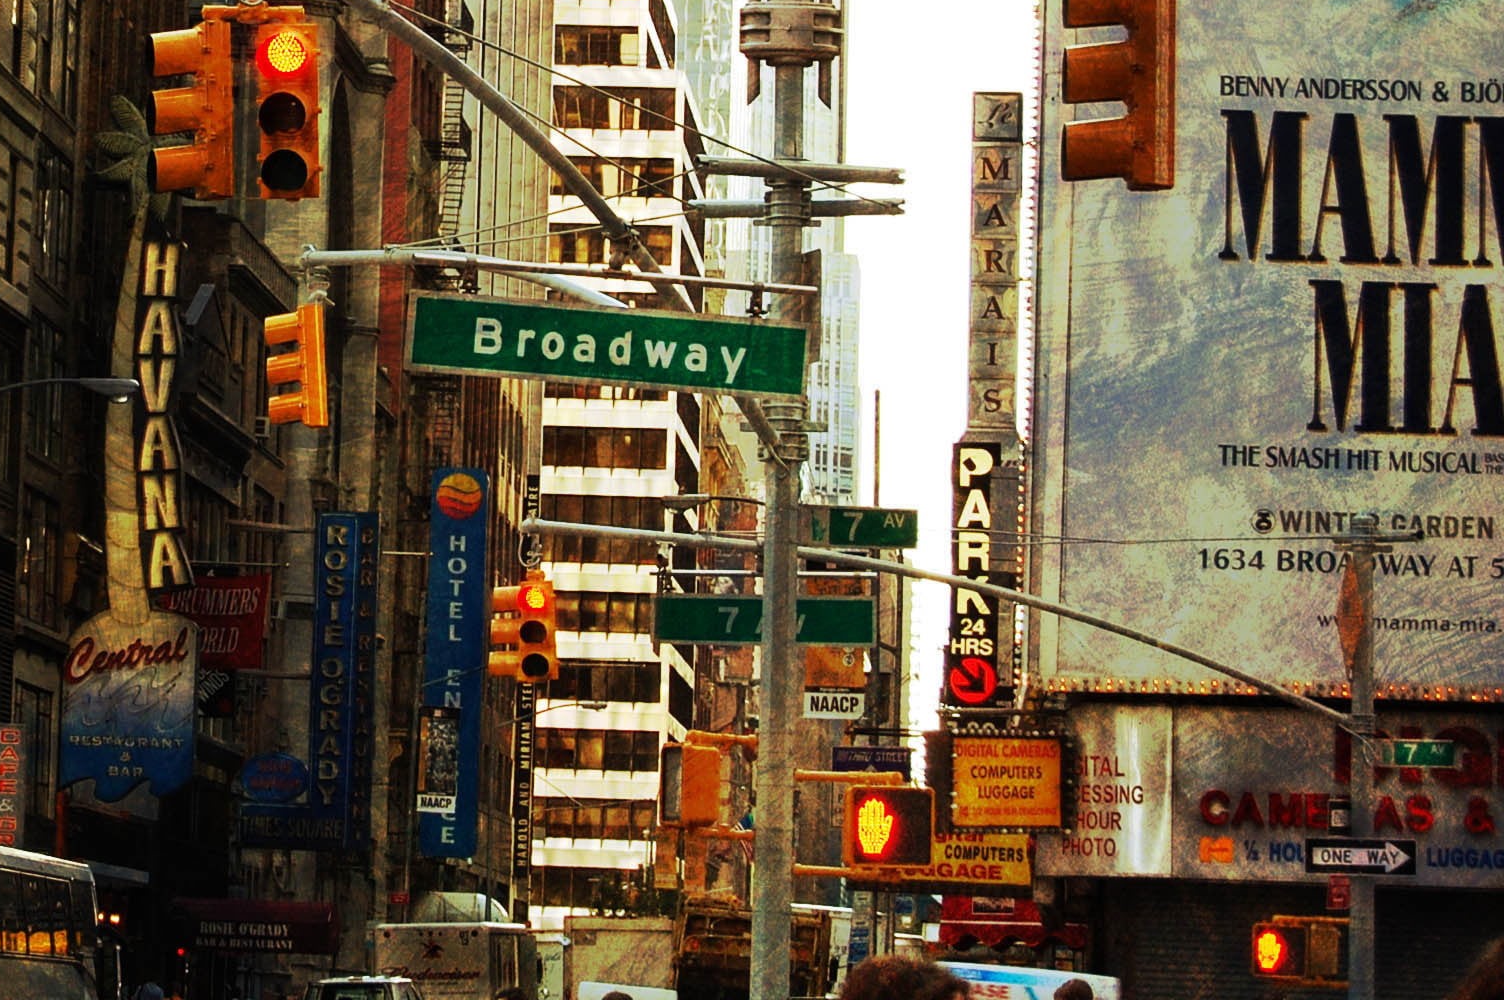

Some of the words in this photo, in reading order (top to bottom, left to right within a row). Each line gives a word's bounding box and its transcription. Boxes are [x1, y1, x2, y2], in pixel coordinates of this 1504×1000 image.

[1220, 75, 1289, 98] BENNY
[1294, 78, 1422, 102] ANDERSSON
[1431, 81, 1450, 102] &
[979, 156, 1012, 415] MARAIS
[474, 317, 747, 384] Broadway
[1307, 278, 1504, 436] MIA
[138, 241, 188, 589] HAVANA
[1218, 444, 1261, 468] THE
[1265, 446, 1340, 470] SMASH
[1347, 449, 1384, 471] HIT
[1389, 451, 1482, 475] MUSICAL
[843, 512, 864, 541] 7
[883, 514, 905, 529] AV
[957, 448, 994, 616] PARK
[1391, 514, 1495, 541] GARDEN
[1198, 547, 1266, 571] 1634
[1277, 549, 1437, 577] BROWAY
[1447, 555, 1479, 578] AT
[323, 524, 351, 647] ROSIE
[445, 534, 469, 643] HOTEL
[167, 587, 261, 616] DRUMMERS
[717, 606, 739, 633] 7
[960, 619, 987, 636] 24
[1317, 614, 1503, 633] wmamma-mia.
[199, 626, 240, 654] ORLD
[951, 638, 994, 656] HRS
[66, 626, 189, 685] Central
[809, 693, 860, 713] NAACP
[69, 734, 185, 749] RESTAURANT
[520, 720, 533, 771] MIRIAM
[956, 743, 999, 757] DIGITAL
[1002, 743, 1057, 758] CAMERAS
[1402, 743, 1418, 764] 7
[1430, 743, 1446, 755] AV
[108, 764, 145, 777] BAR
[970, 765, 1043, 780] COMPUTERS
[1074, 755, 1125, 778] GITAL
[420, 796, 453, 810] NAACP
[519, 781, 530, 807] AND
[977, 785, 1036, 799] LUGGAGE
[1074, 784, 1144, 804] ESSING
[1199, 789, 1434, 834] CAMEAS
[1463, 798, 1495, 834] &
[516, 818, 529, 868] HAROLD
[945, 844, 1024, 862] COMPUTERS
[1062, 837, 1117, 857] PHOTO
[1268, 842, 1305, 863] HOU
[1321, 850, 1354, 865] ONE
[1367, 849, 1400, 866] WAY
[381, 967, 482, 982] Budweiser
